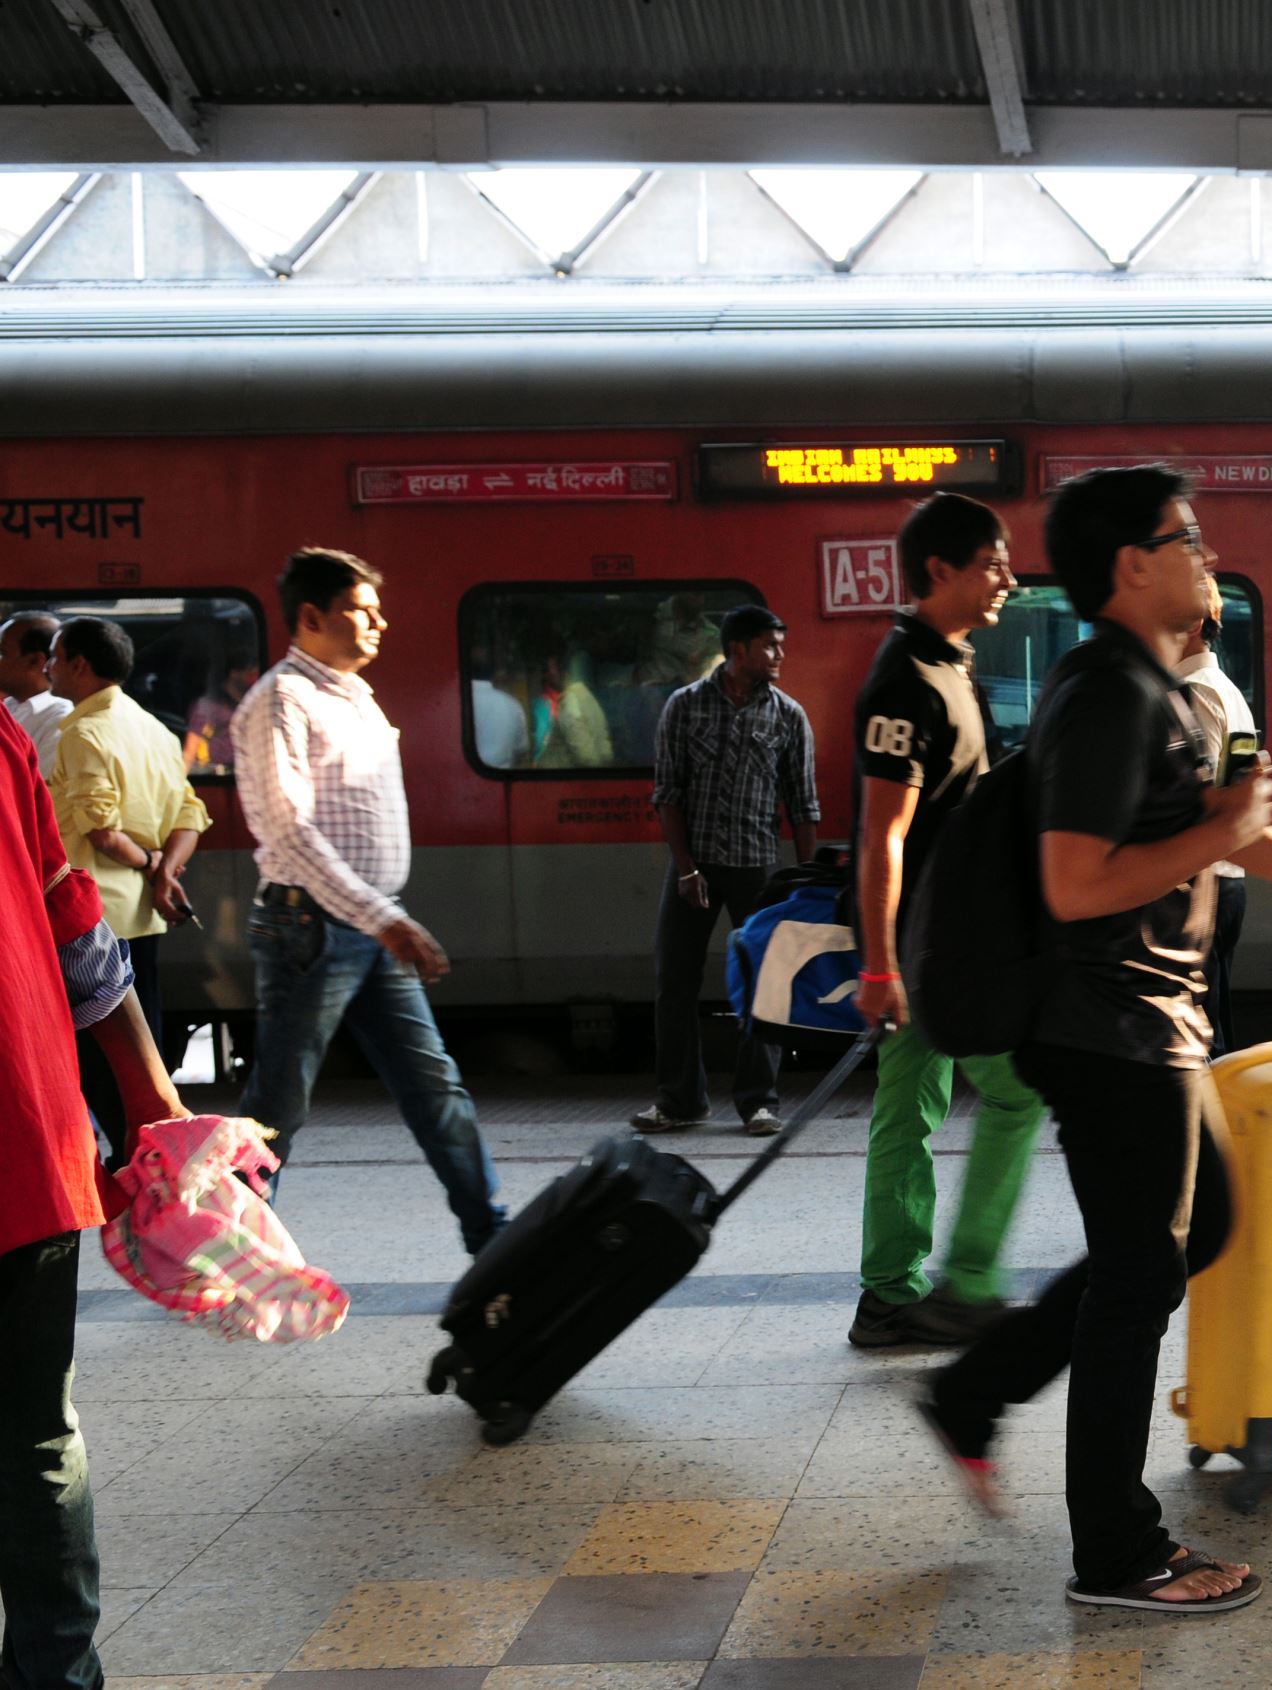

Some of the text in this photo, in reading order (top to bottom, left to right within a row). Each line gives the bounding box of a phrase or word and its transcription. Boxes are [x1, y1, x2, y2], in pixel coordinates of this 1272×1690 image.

[777, 463, 935, 484] WELCOMES YOU
[832, 548, 891, 605] A-5
[865, 715, 914, 757] 08
